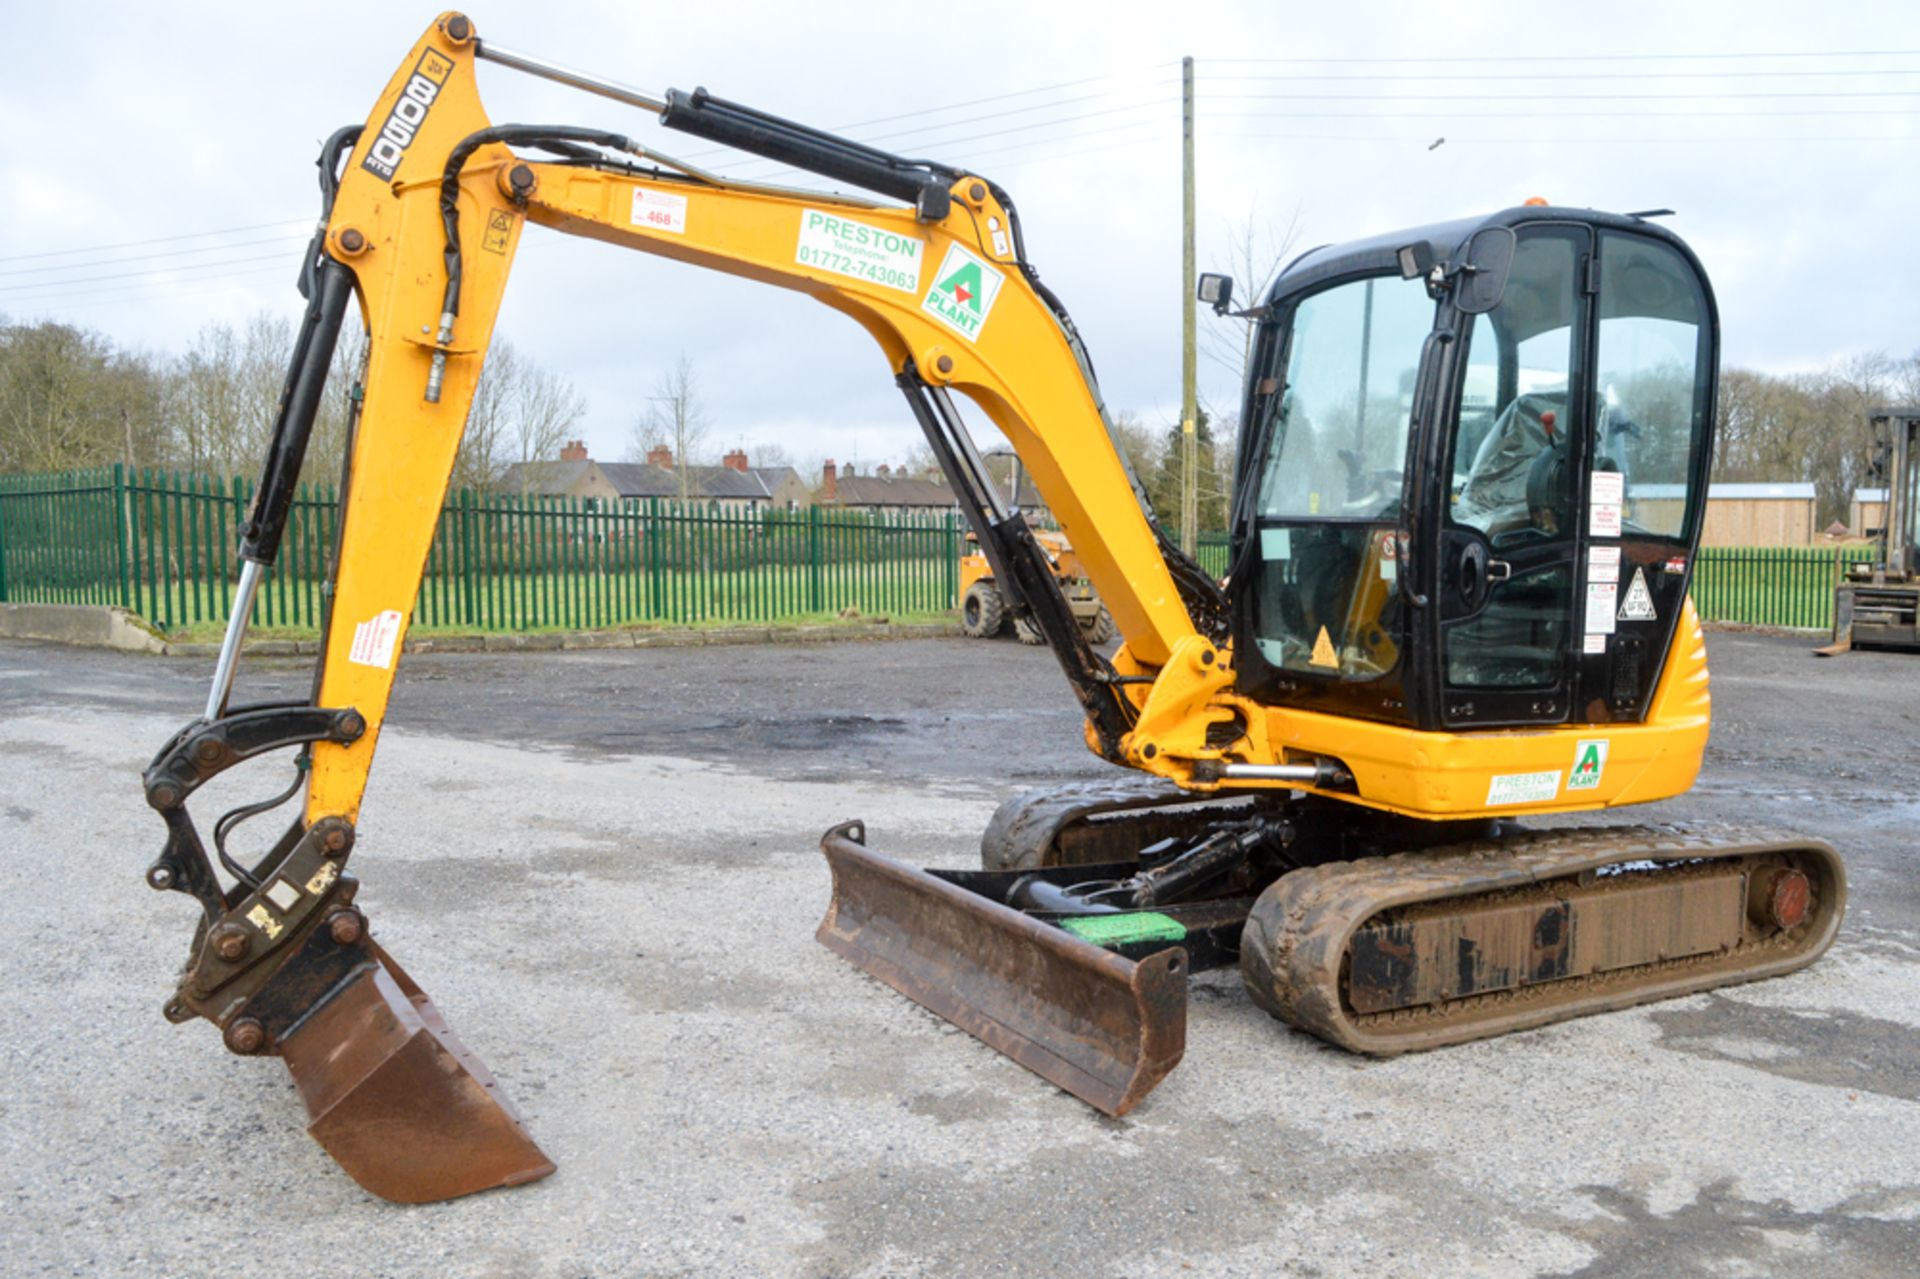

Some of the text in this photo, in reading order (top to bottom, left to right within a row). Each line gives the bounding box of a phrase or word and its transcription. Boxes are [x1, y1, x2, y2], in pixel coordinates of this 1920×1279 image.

[371, 74, 439, 167] 8050
[647, 211, 671, 225] 468
[808, 212, 916, 258] PRESTON
[800, 245, 916, 290] 01772-743063
[938, 261, 982, 314] A
[927, 291, 980, 332] PLANT
[1575, 744, 1599, 774] A
[1496, 773, 1557, 788] PRESTON
[1569, 775, 1600, 787] PLANT
